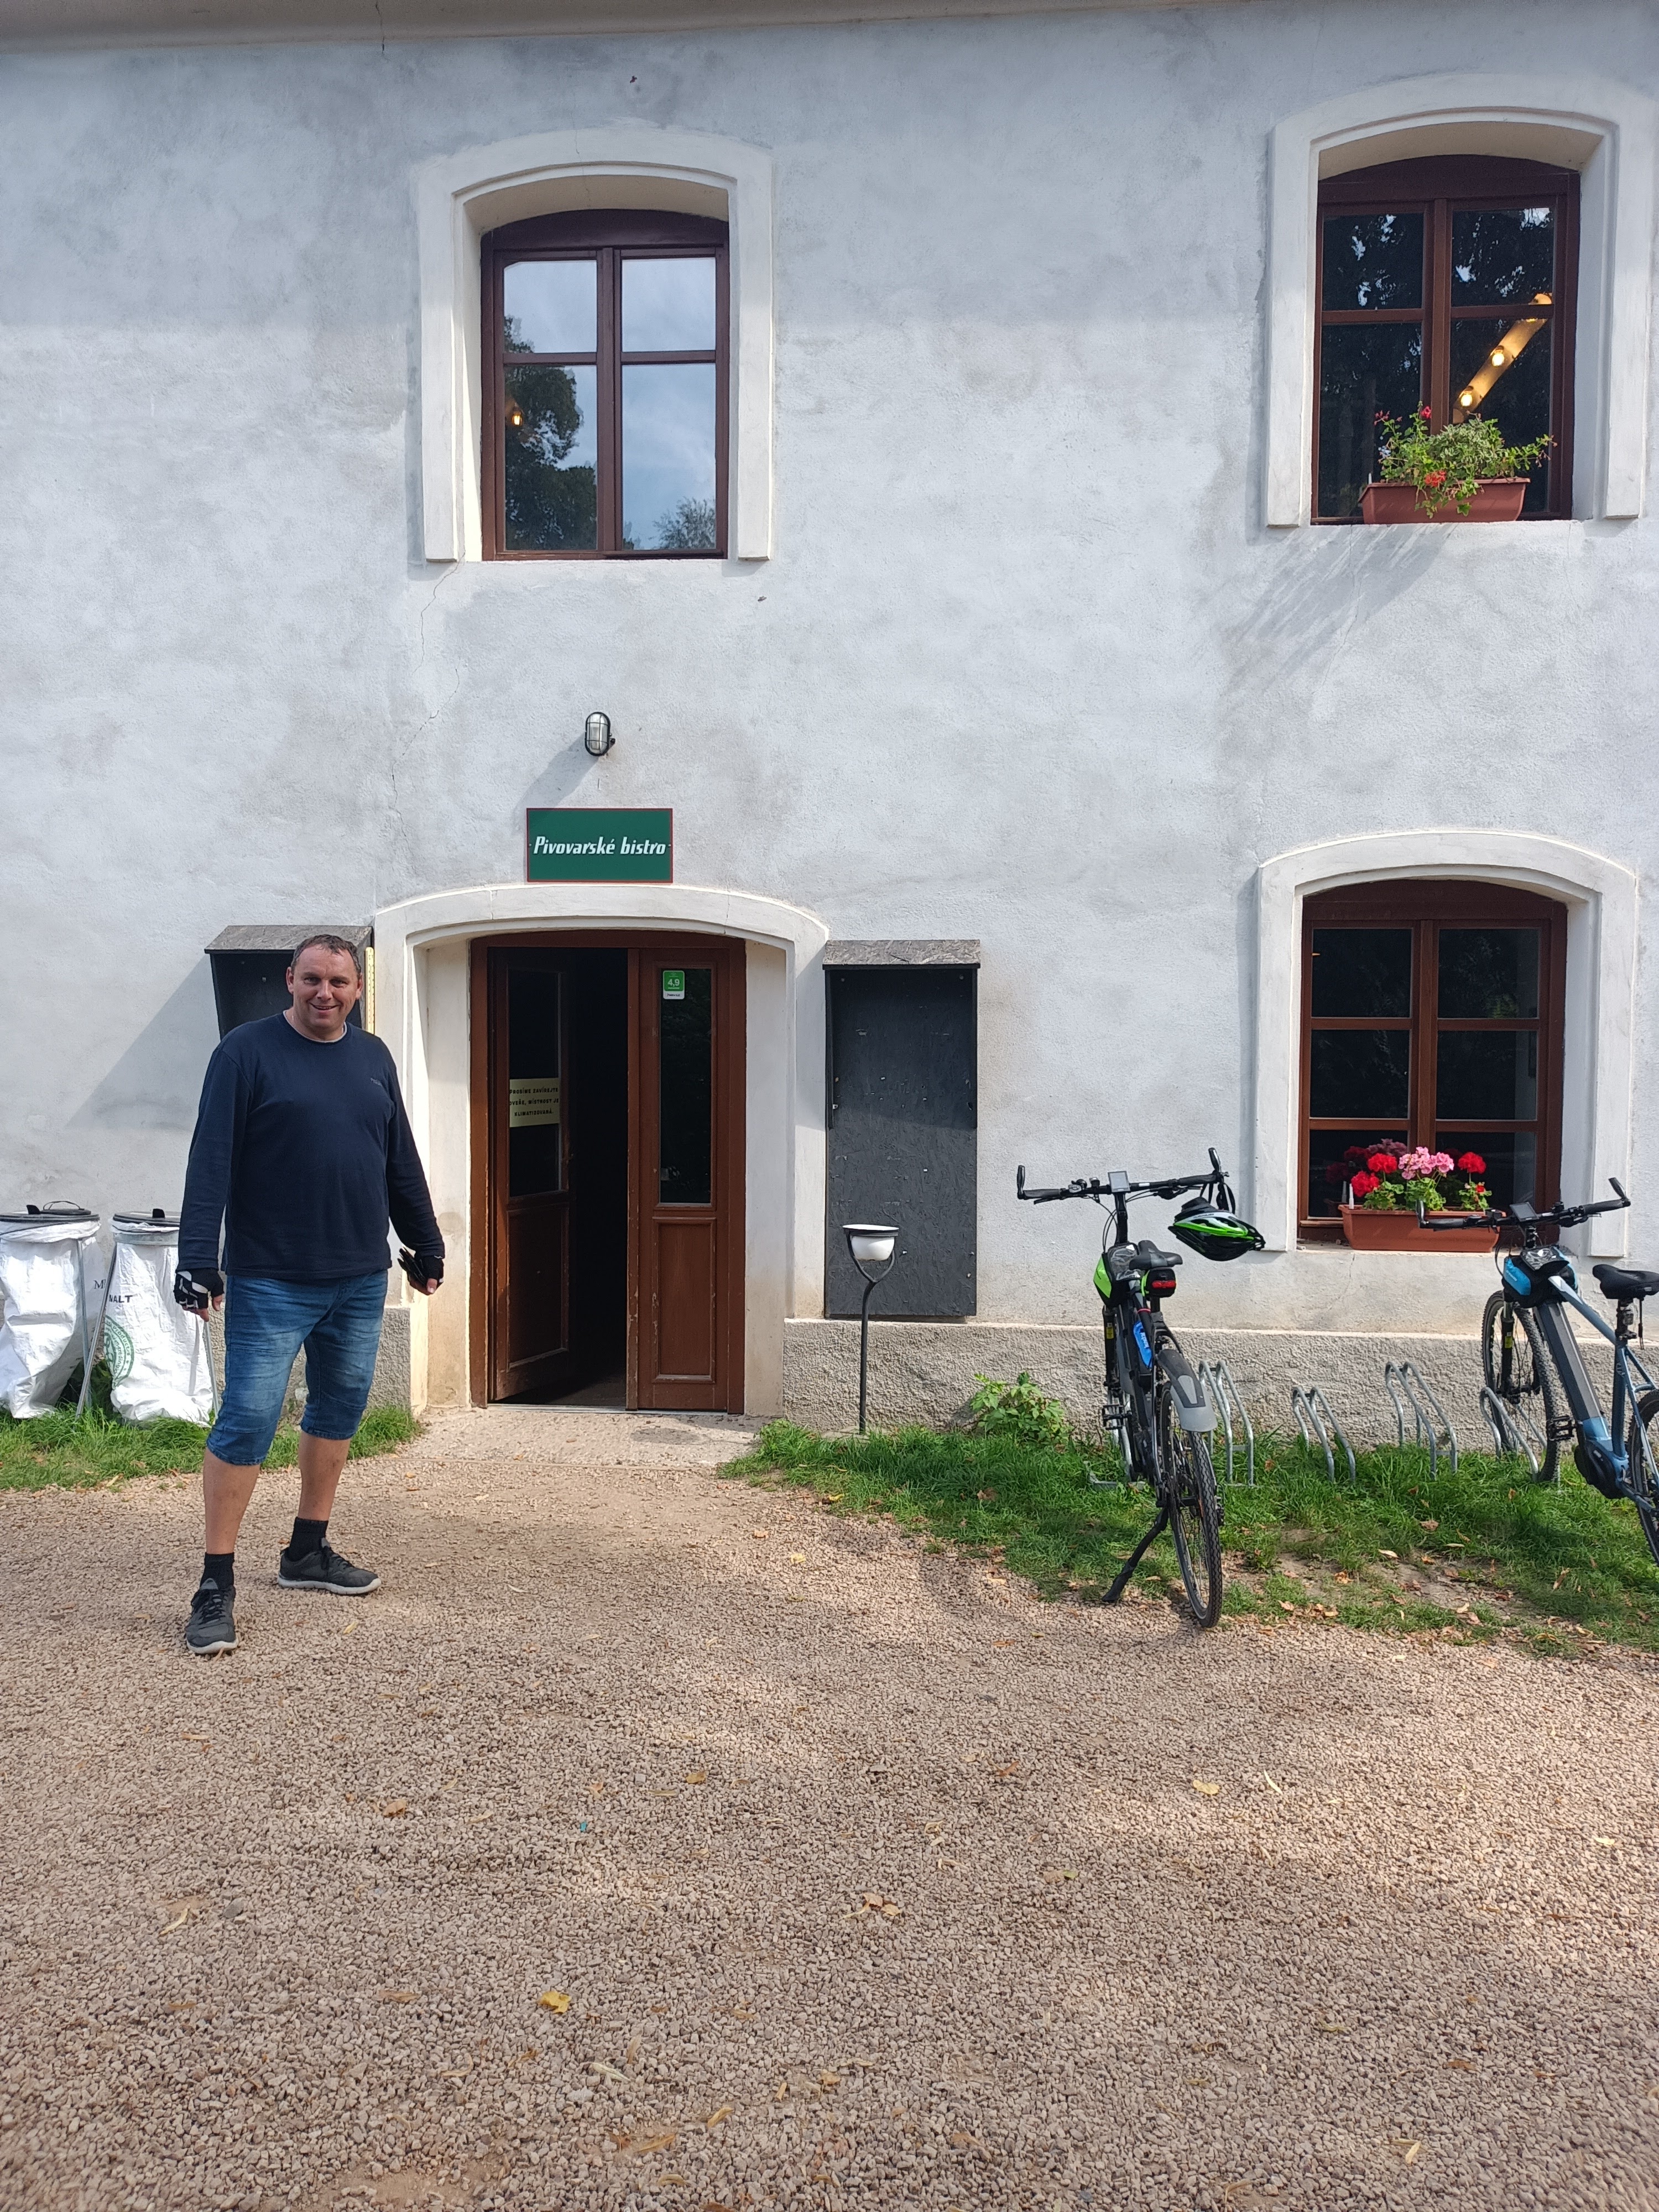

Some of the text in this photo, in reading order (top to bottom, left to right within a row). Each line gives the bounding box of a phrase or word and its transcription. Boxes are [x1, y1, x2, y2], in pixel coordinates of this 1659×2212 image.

[533, 836, 666, 854] Pivovarské bistro
[667, 978, 680, 987] 4,9
